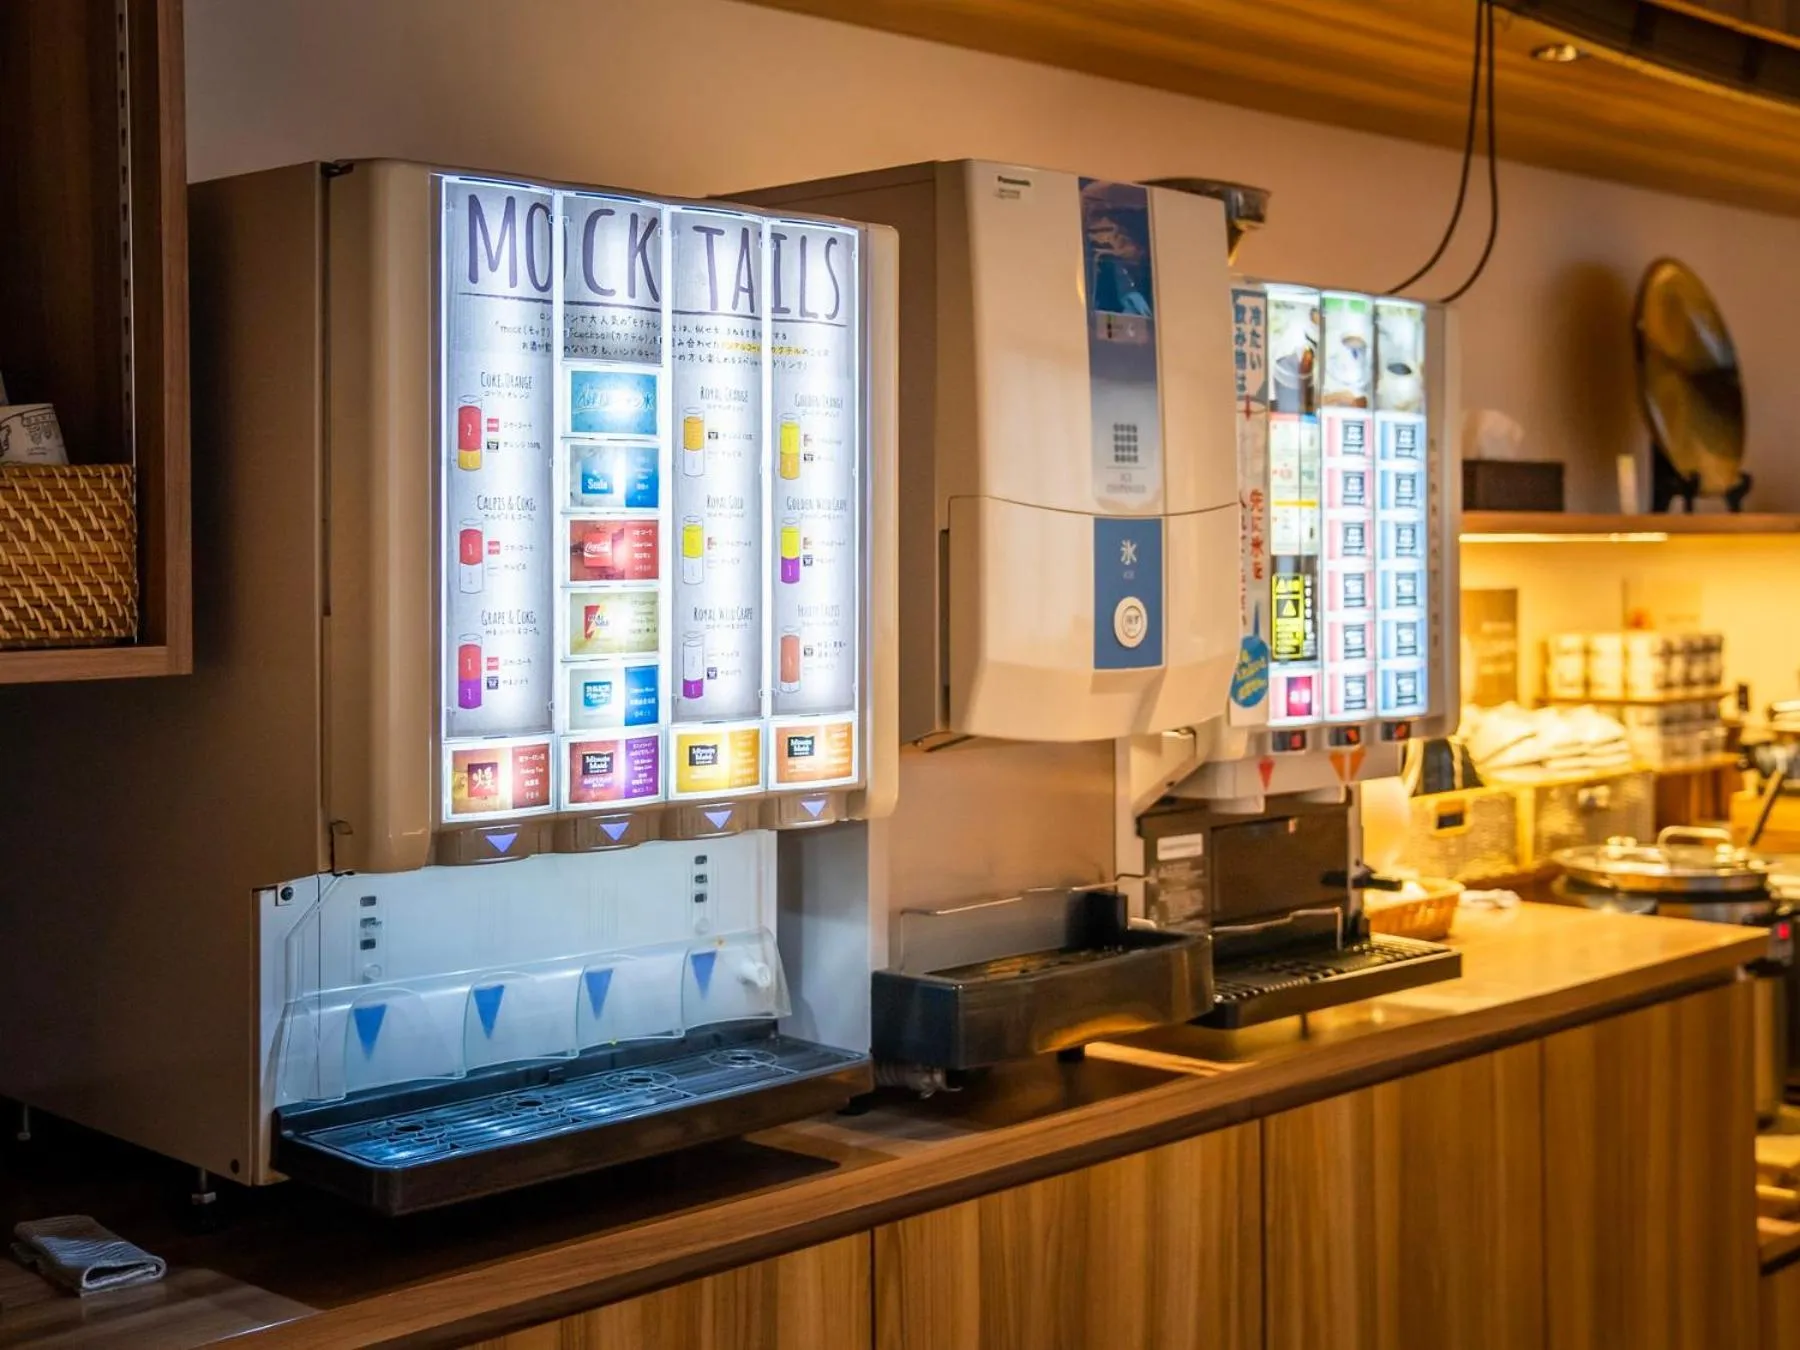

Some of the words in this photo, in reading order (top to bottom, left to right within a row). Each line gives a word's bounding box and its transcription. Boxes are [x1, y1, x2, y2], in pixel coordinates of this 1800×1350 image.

[467, 193, 660, 303] MOCK
[693, 224, 840, 322] TAILS
[1120, 540, 1137, 565] 氷
[585, 756, 610, 764] Minute
